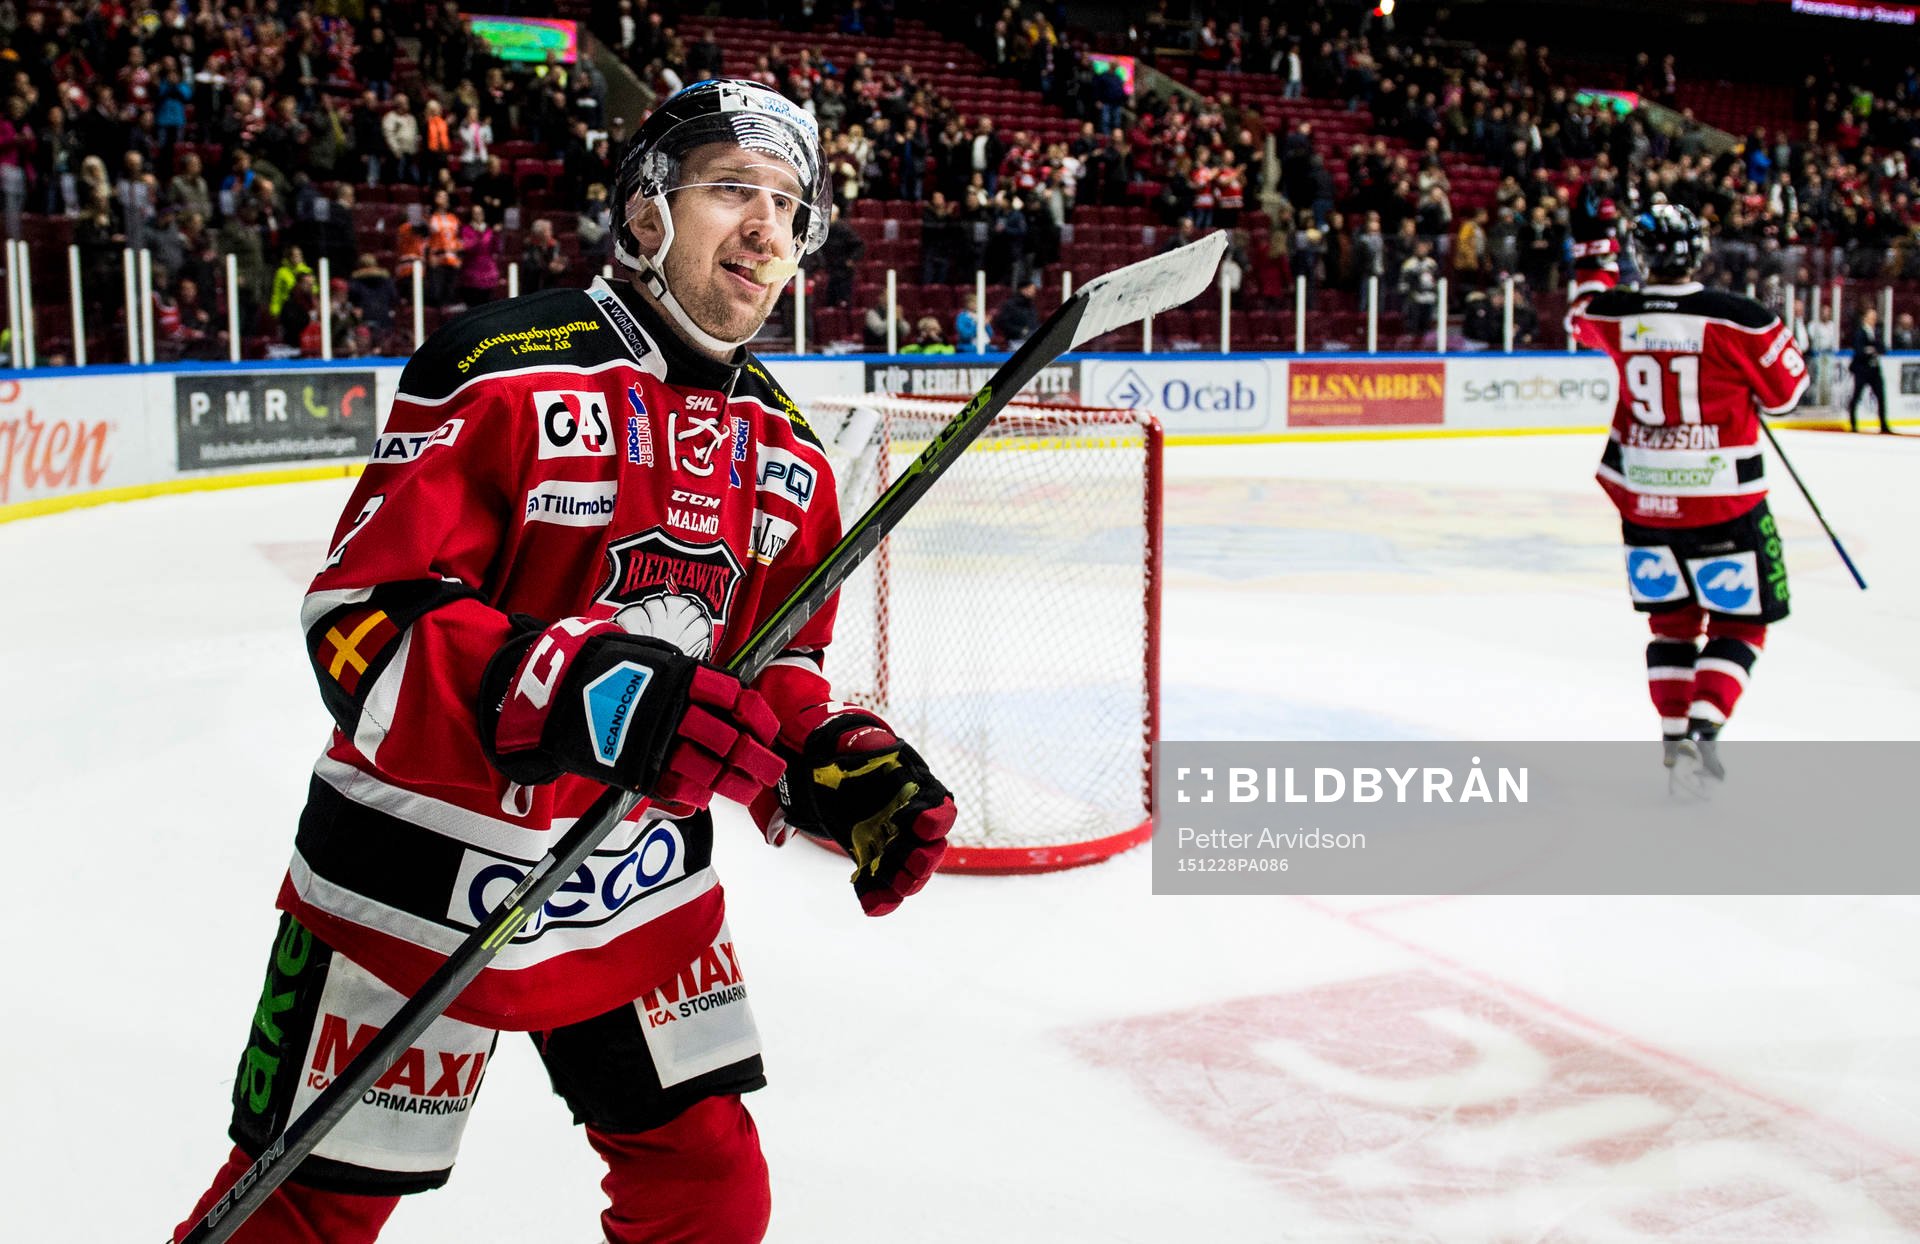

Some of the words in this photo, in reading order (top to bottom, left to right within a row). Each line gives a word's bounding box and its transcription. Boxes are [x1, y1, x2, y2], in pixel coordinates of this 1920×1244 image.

[457, 320, 599, 373] Ställningsbyggarna
[554, 340, 572, 351] AB
[611, 305, 645, 355] Wihlborgs
[685, 394, 718, 412] SHL
[1161, 378, 1256, 412] Ocab
[1291, 373, 1443, 400] ELSNABBEN
[1463, 375, 1610, 406] sandberg
[1625, 355, 1702, 425] 91
[545, 394, 608, 452] G4S
[628, 416, 641, 464] SPORT
[637, 416, 654, 466] INTER
[735, 419, 749, 460] SPORT
[671, 489, 721, 510] CCM
[667, 507, 719, 535] MALMÖ
[619, 549, 731, 612] REDHAWKS
[604, 674, 644, 756] SCANDCON
[648, 1009, 678, 1028] ICA
[362, 1089, 468, 1116] ORMARKNAD
[207, 1134, 286, 1229] CCM
